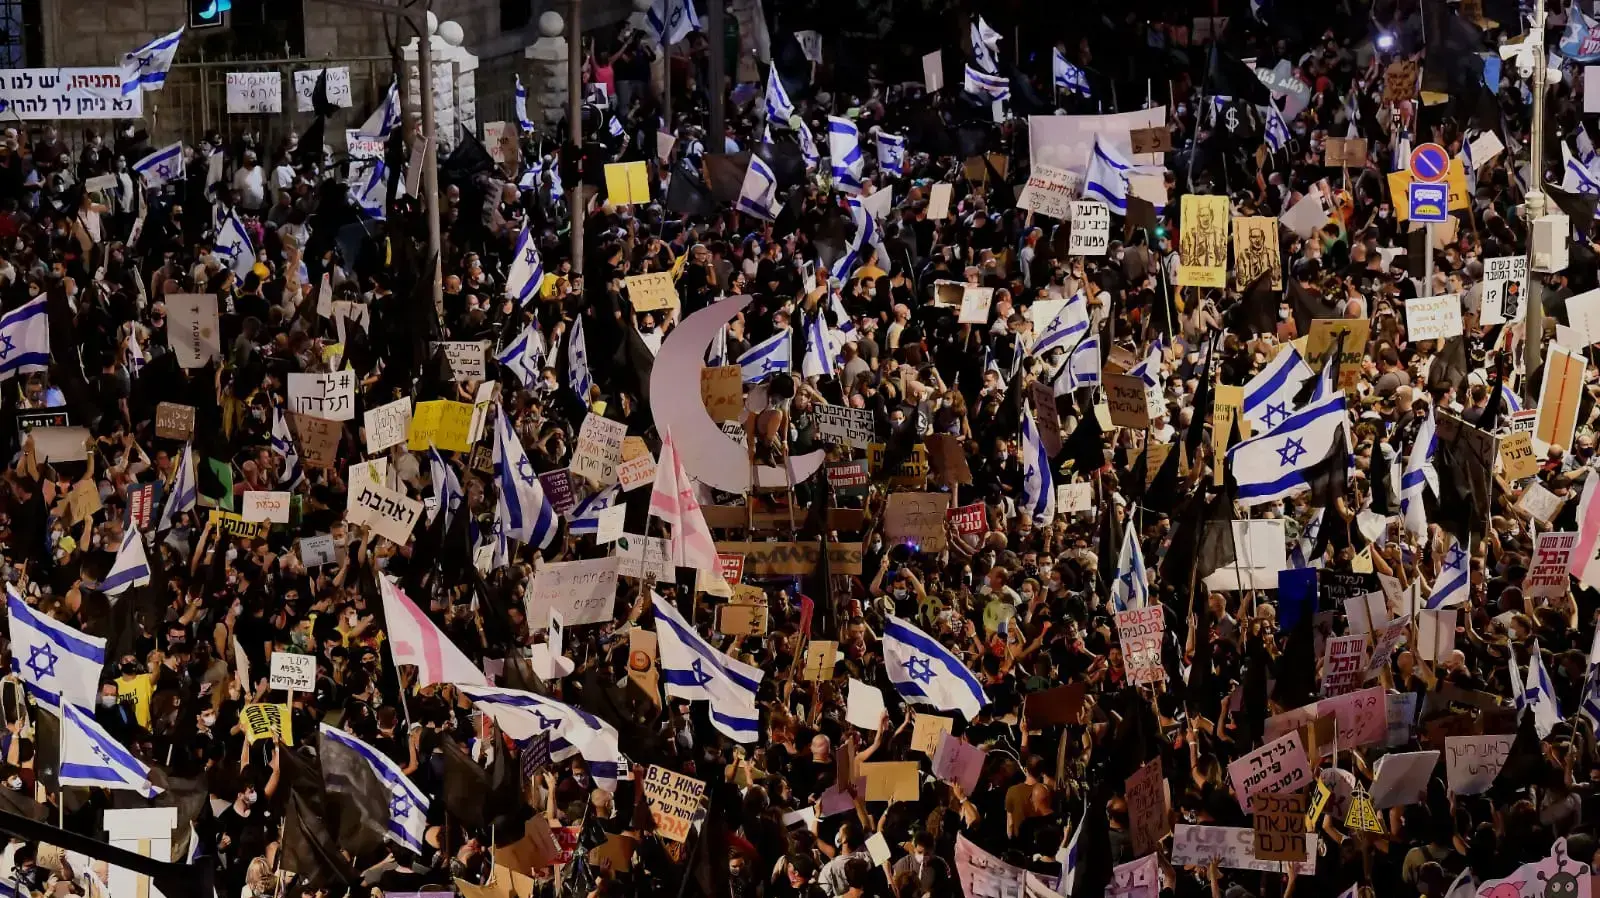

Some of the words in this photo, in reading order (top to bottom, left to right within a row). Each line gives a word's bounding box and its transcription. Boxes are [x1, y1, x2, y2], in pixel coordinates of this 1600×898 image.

[11, 72, 33, 89] לנו
[39, 75, 60, 89] יש
[66, 74, 121, 92] נתניהו,
[10, 94, 47, 112] להרו
[52, 95, 71, 115] לך
[78, 98, 106, 115] ניתן
[112, 99, 132, 111] לא
[1485, 269, 1510, 281] המשבר
[191, 320, 201, 361] TADIRAN
[296, 394, 349, 415] תזדקן
[1537, 549, 1570, 565] הכל
[1119, 609, 1161, 626] הנאשם
[280, 664, 303, 674] 1933
[1329, 655, 1360, 673] הכל
[1249, 739, 1296, 770] גלידה
[647, 766, 671, 787] B.B.
[675, 776, 704, 797] KING
[1242, 761, 1282, 793] פיסטוק
[664, 789, 680, 803] רק
[681, 796, 699, 808] היה
[1256, 795, 1302, 814] בגלל
[657, 800, 672, 814] שר
[674, 807, 695, 821] והוא
[1256, 814, 1304, 832] שנאת
[1260, 834, 1307, 853] חינם
